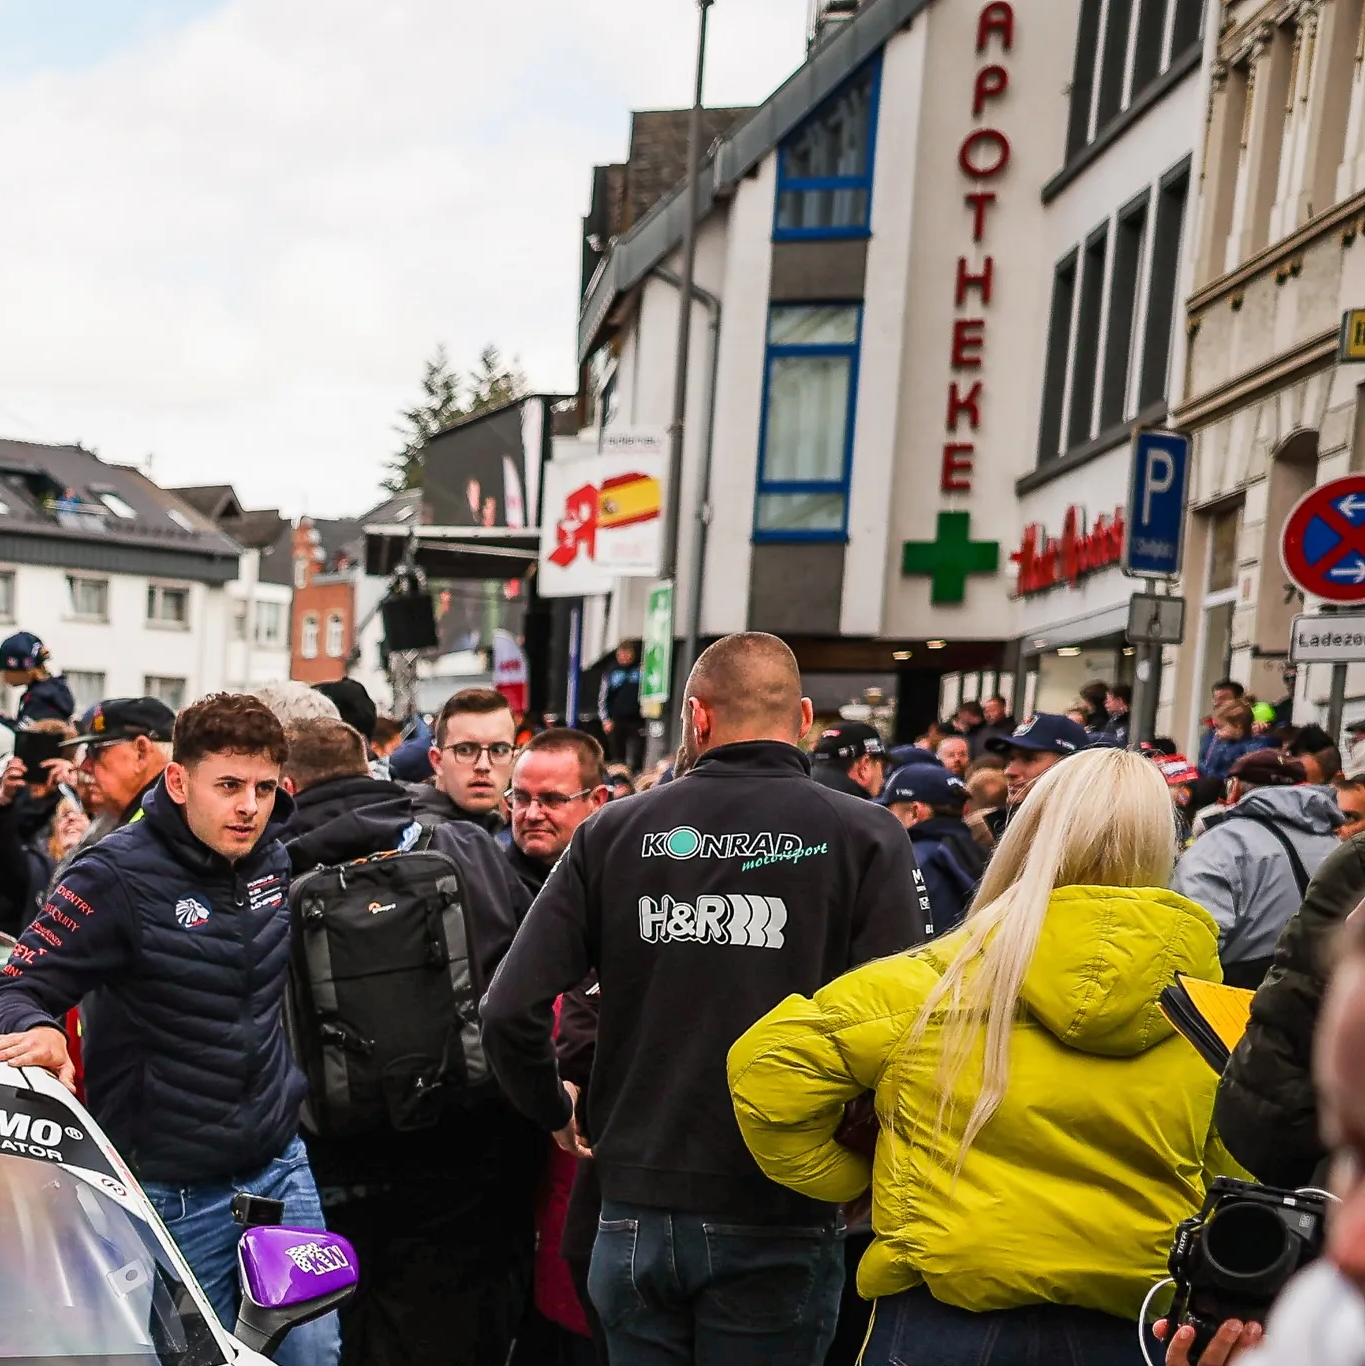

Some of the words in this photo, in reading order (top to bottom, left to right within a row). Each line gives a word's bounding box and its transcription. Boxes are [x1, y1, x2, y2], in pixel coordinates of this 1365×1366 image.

[940, 0, 1014, 493] APOTHEKE
[641, 825, 803, 861] KONRAD
[741, 842, 829, 872] motorsport
[57, 885, 94, 916] OVENTRY
[638, 893, 731, 945] H&R
[1176, 1230, 1189, 1255] TILTA
